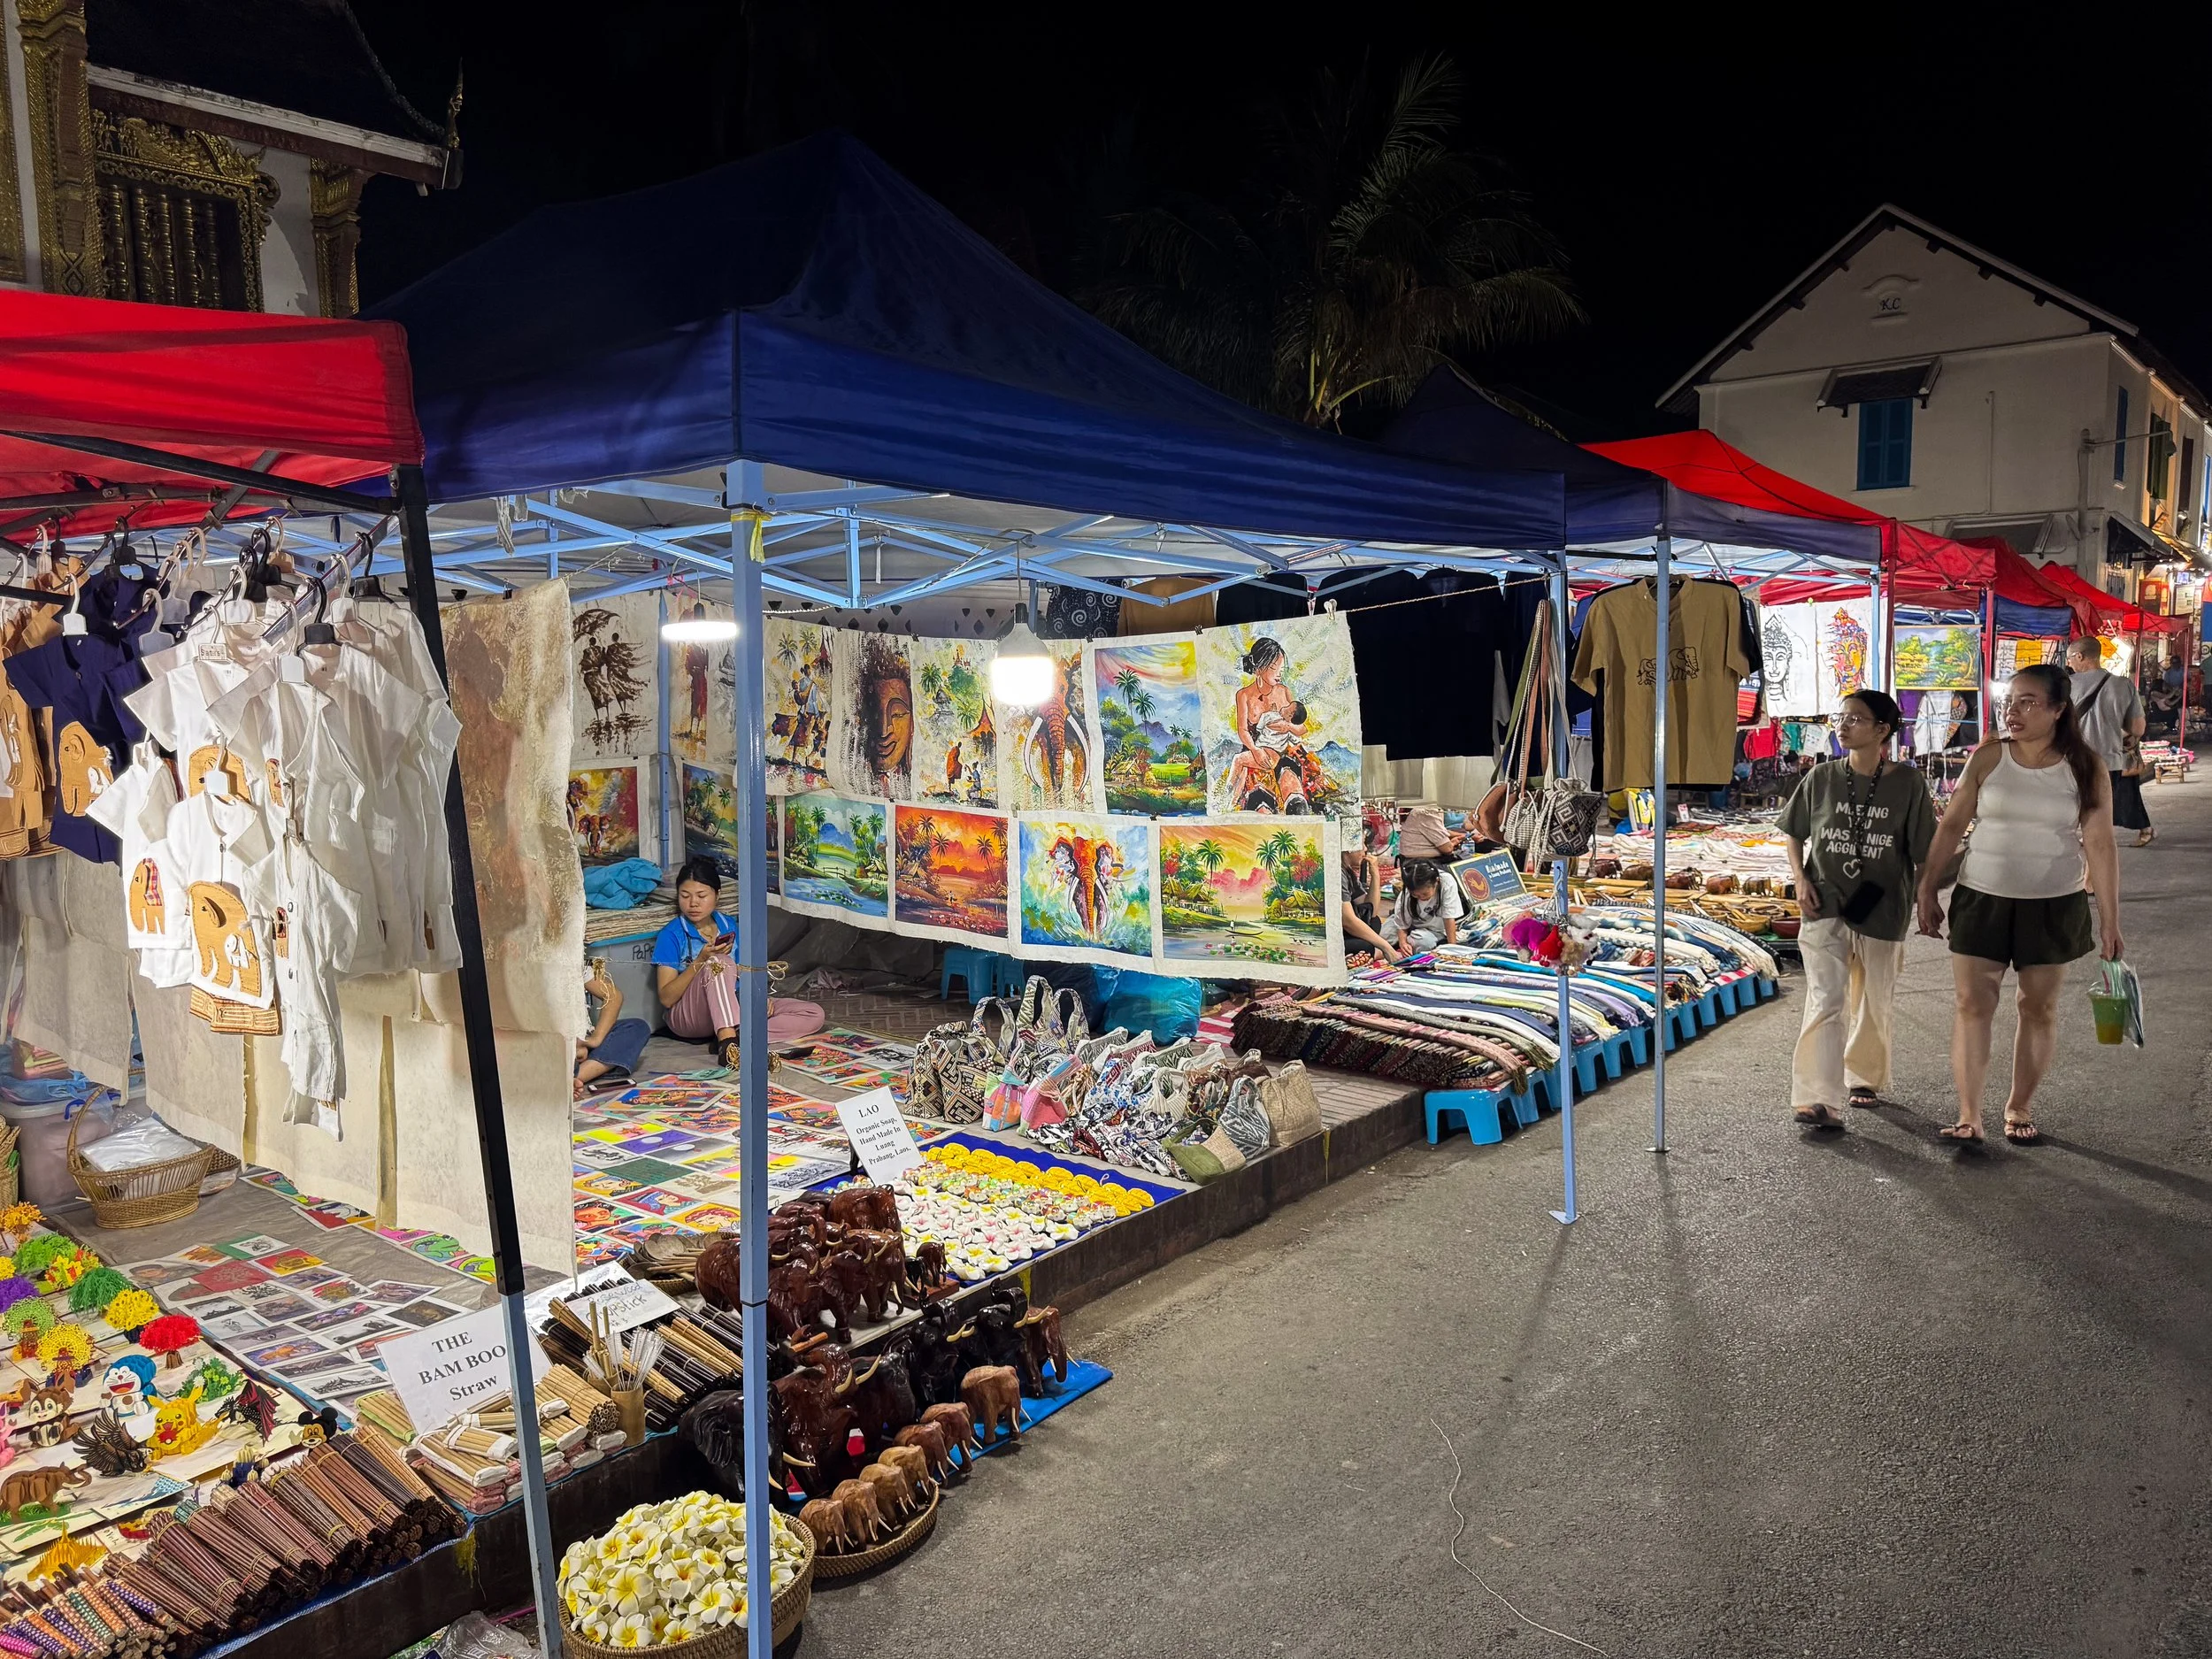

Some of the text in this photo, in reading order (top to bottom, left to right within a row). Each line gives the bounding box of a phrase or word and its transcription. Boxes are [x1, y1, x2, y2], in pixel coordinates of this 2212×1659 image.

[1836, 802, 1889, 818] MEING
[1820, 826, 1851, 841] WAS
[858, 1104, 879, 1118] LAO
[856, 1122, 880, 1135] Organic
[859, 1134, 877, 1146] Hand
[877, 1129, 894, 1140] Made
[875, 1140, 895, 1151] Luang
[432, 1332, 473, 1354] THE
[418, 1344, 507, 1385] BAM BOO
[449, 1375, 498, 1402] Straw
